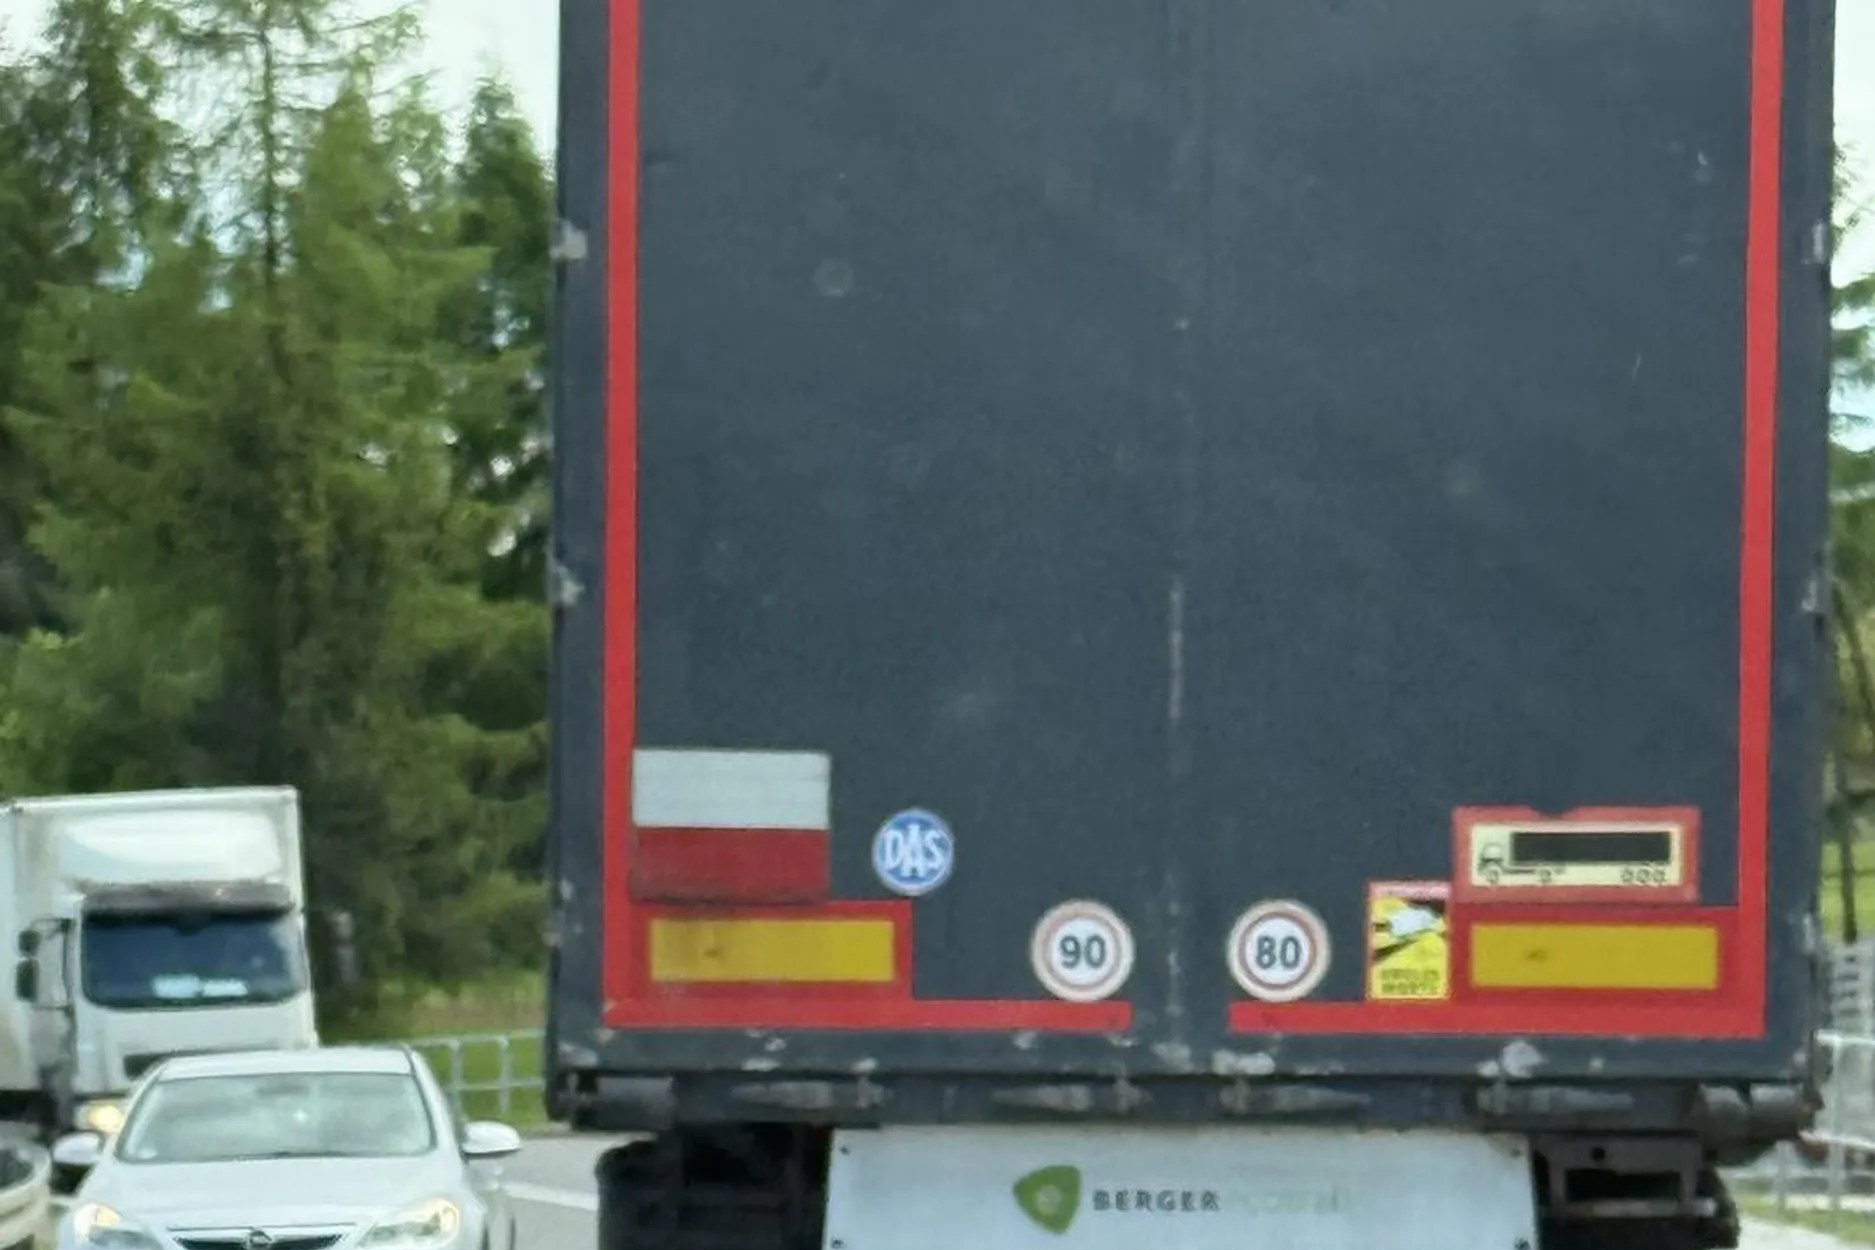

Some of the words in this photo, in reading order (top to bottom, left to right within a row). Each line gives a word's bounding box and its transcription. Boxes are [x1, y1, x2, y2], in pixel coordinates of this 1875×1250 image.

[882, 824, 945, 877] DAS
[1060, 935, 1106, 968] 90
[1255, 935, 1301, 969] 80
[1093, 1189, 1221, 1212] BERGER
